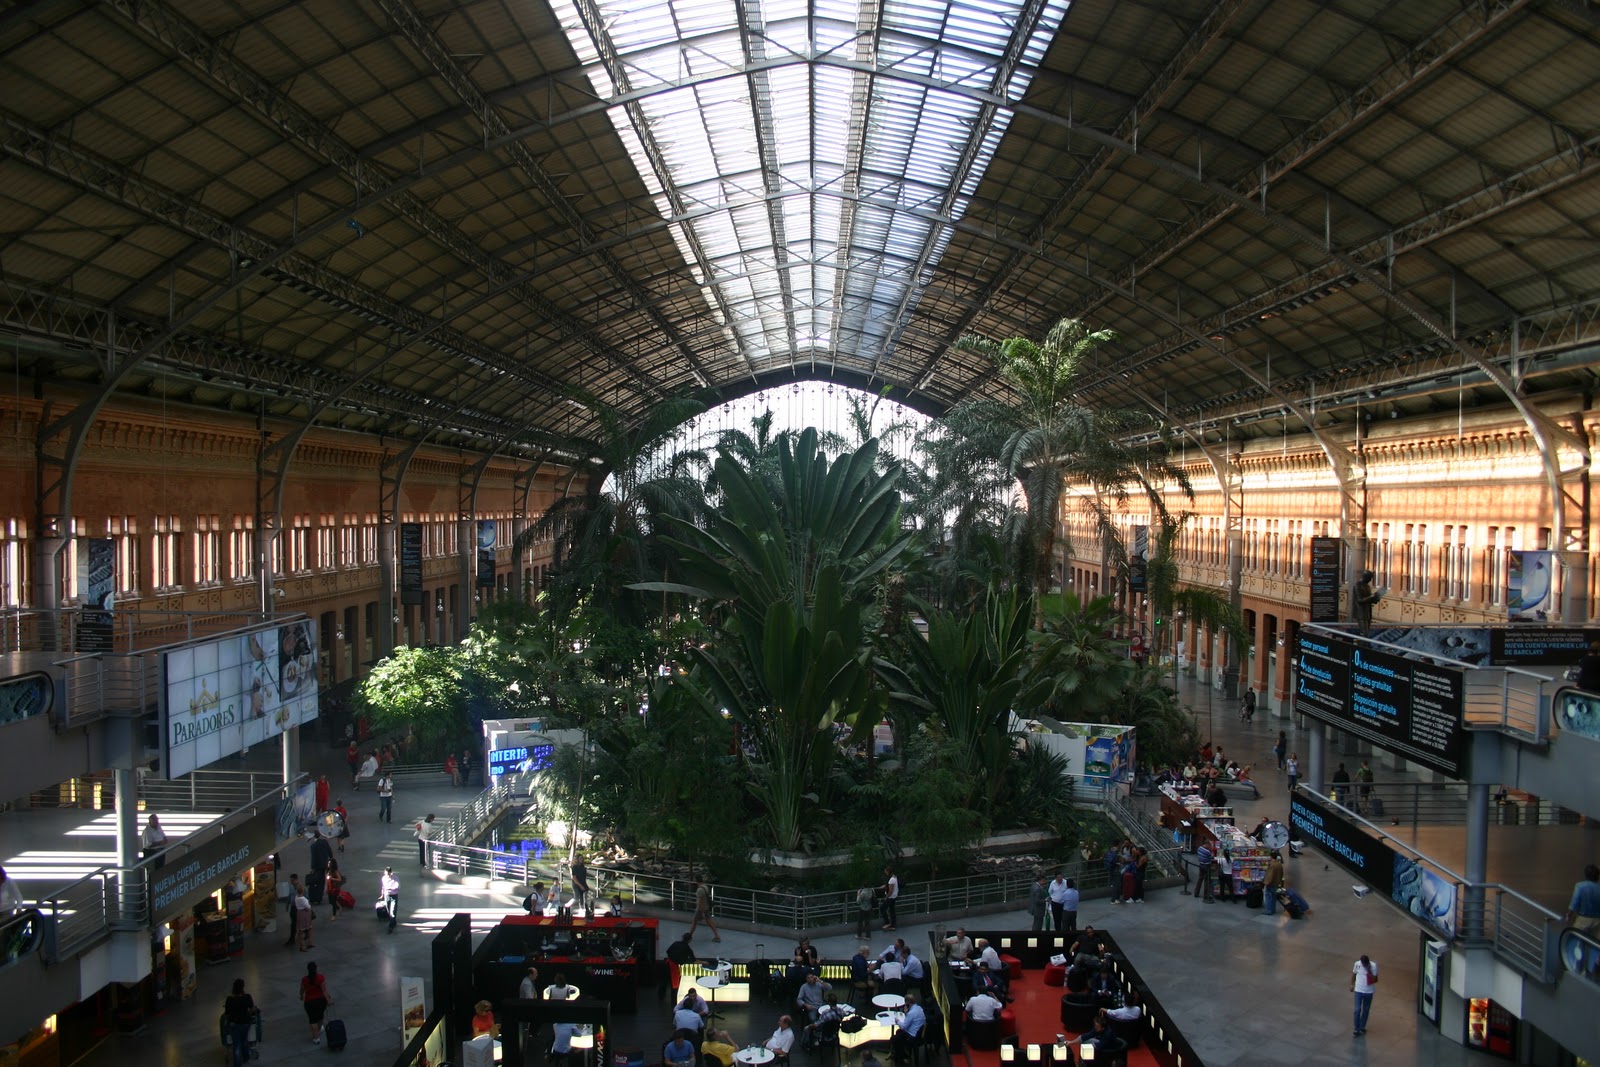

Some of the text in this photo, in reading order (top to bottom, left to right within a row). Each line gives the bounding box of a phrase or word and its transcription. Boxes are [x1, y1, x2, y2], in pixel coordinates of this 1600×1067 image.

[1312, 643, 1329, 654] personal
[1363, 660, 1369, 670] de
[1369, 664, 1394, 678] comisiones
[1354, 672, 1371, 686] Tarjetas
[1371, 680, 1392, 693] gratuitas
[1353, 692, 1377, 709] Disposición
[1377, 702, 1397, 716] gratuita
[1353, 702, 1359, 712] de
[173, 704, 235, 746] PARADORES
[1292, 801, 1324, 827] NUEVA CUENTA
[1292, 813, 1364, 868] PREMIER LIFE DE BARCLAYS
[154, 860, 201, 895] NUEVA CUENTA
[154, 844, 250, 912] PREMIER LIFE DE BARCLAYS
